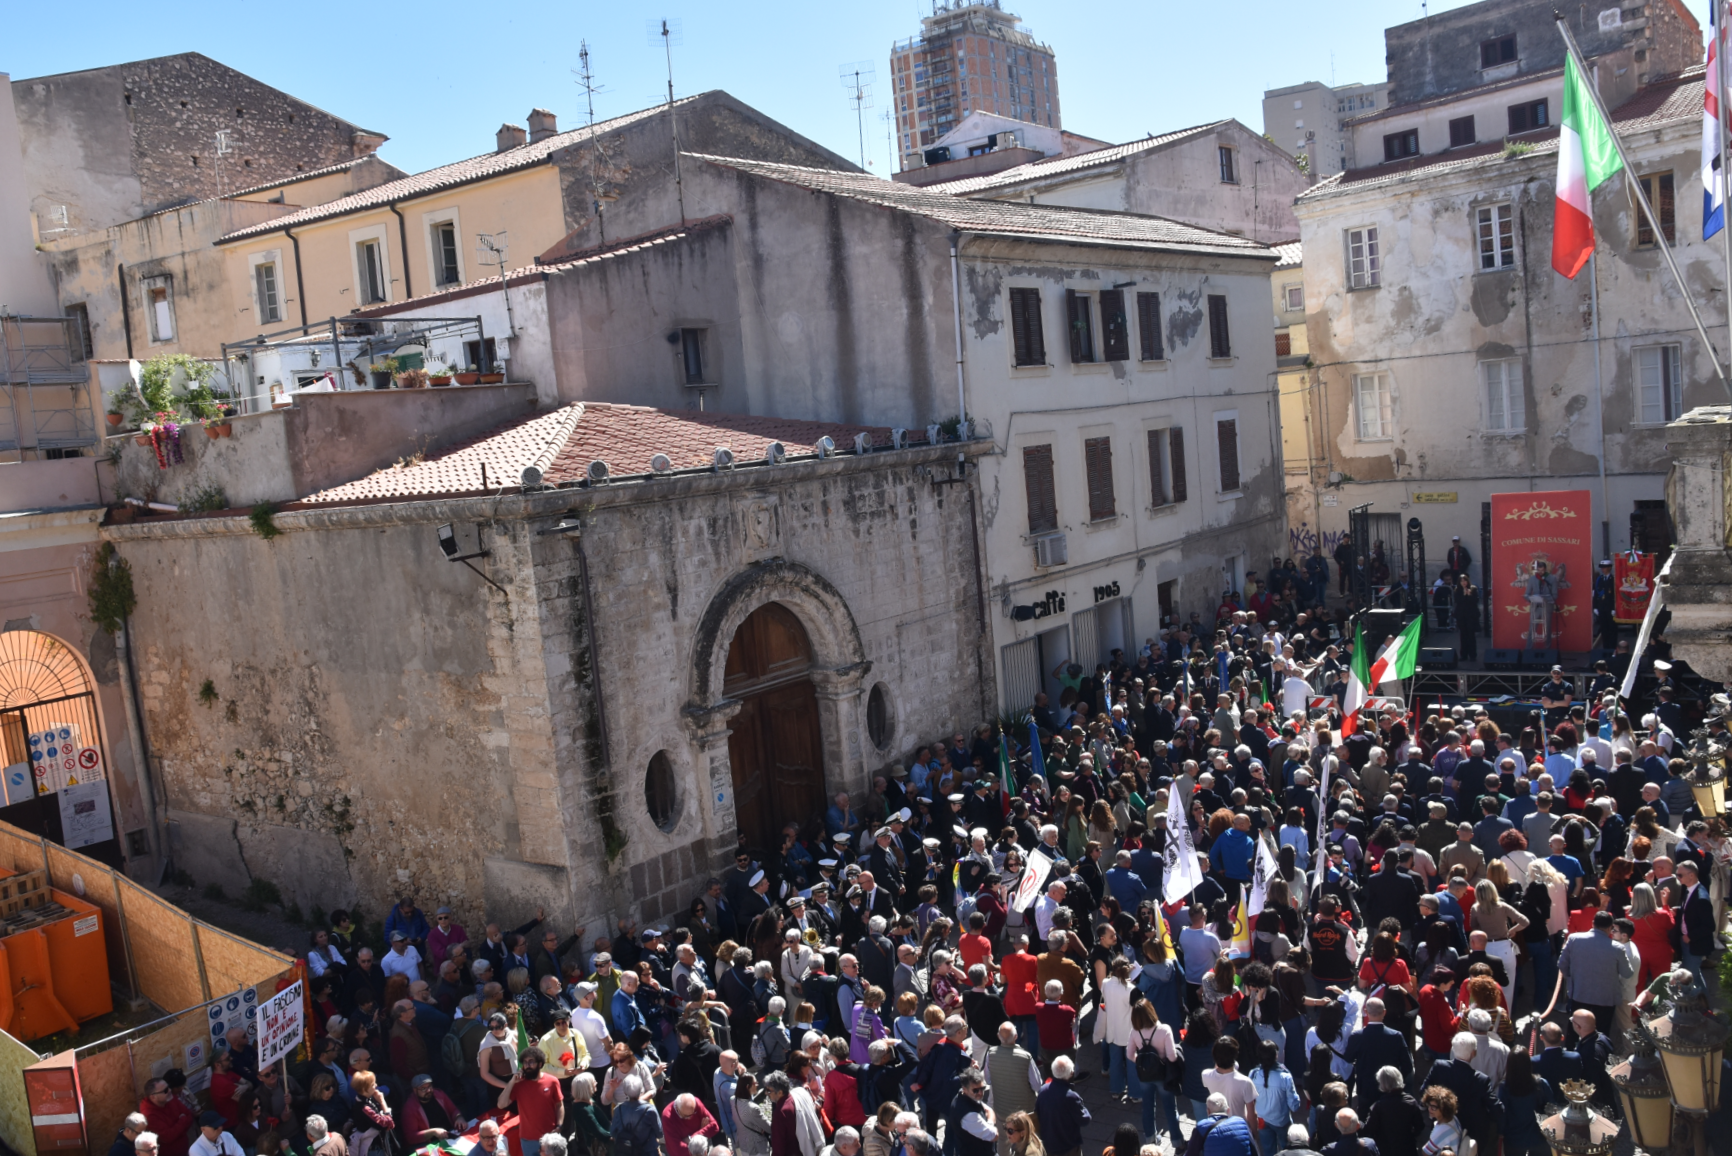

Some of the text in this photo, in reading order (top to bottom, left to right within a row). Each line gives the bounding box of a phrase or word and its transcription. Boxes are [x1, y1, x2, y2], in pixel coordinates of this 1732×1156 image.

[1501, 536, 1536, 547] COMUNE
[1547, 536, 1580, 546] SASSARI
[1092, 580, 1121, 603] 1903
[261, 983, 302, 1021] IL FASCISMO
[266, 1013, 279, 1033] NON
[270, 1041, 278, 1058] UN
